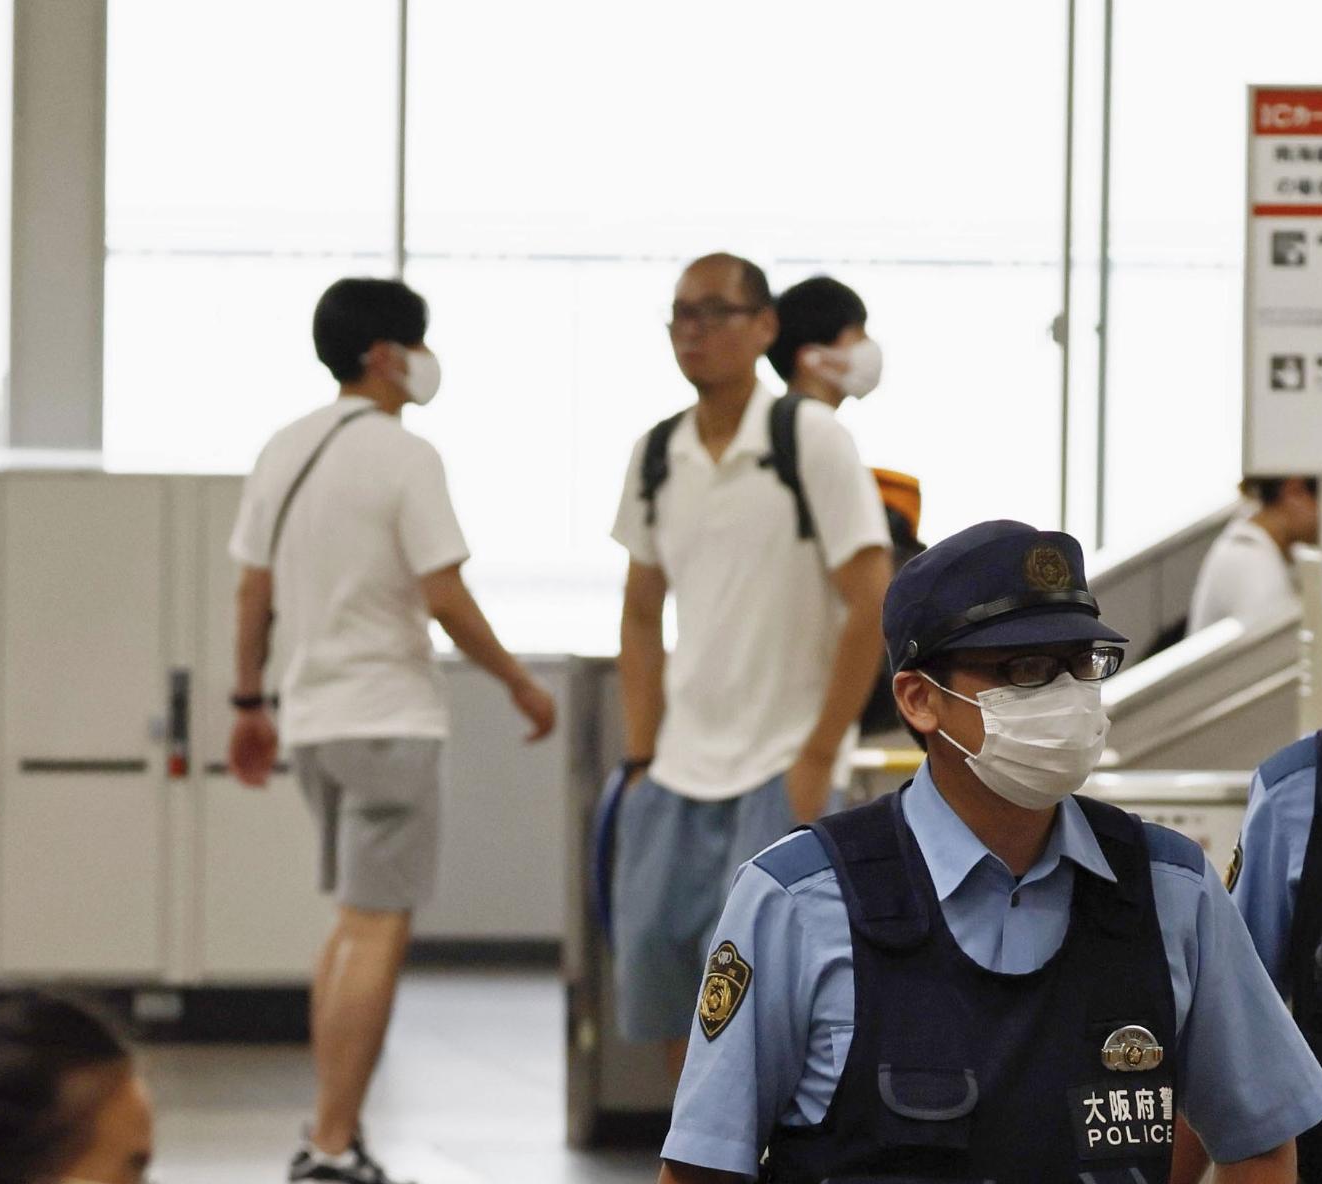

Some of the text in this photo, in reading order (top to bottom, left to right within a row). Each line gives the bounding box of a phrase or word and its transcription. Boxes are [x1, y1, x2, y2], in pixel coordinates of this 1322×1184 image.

[1083, 1086, 1174, 1125] 大阪府警
[1087, 1124, 1173, 1148] POLICE
